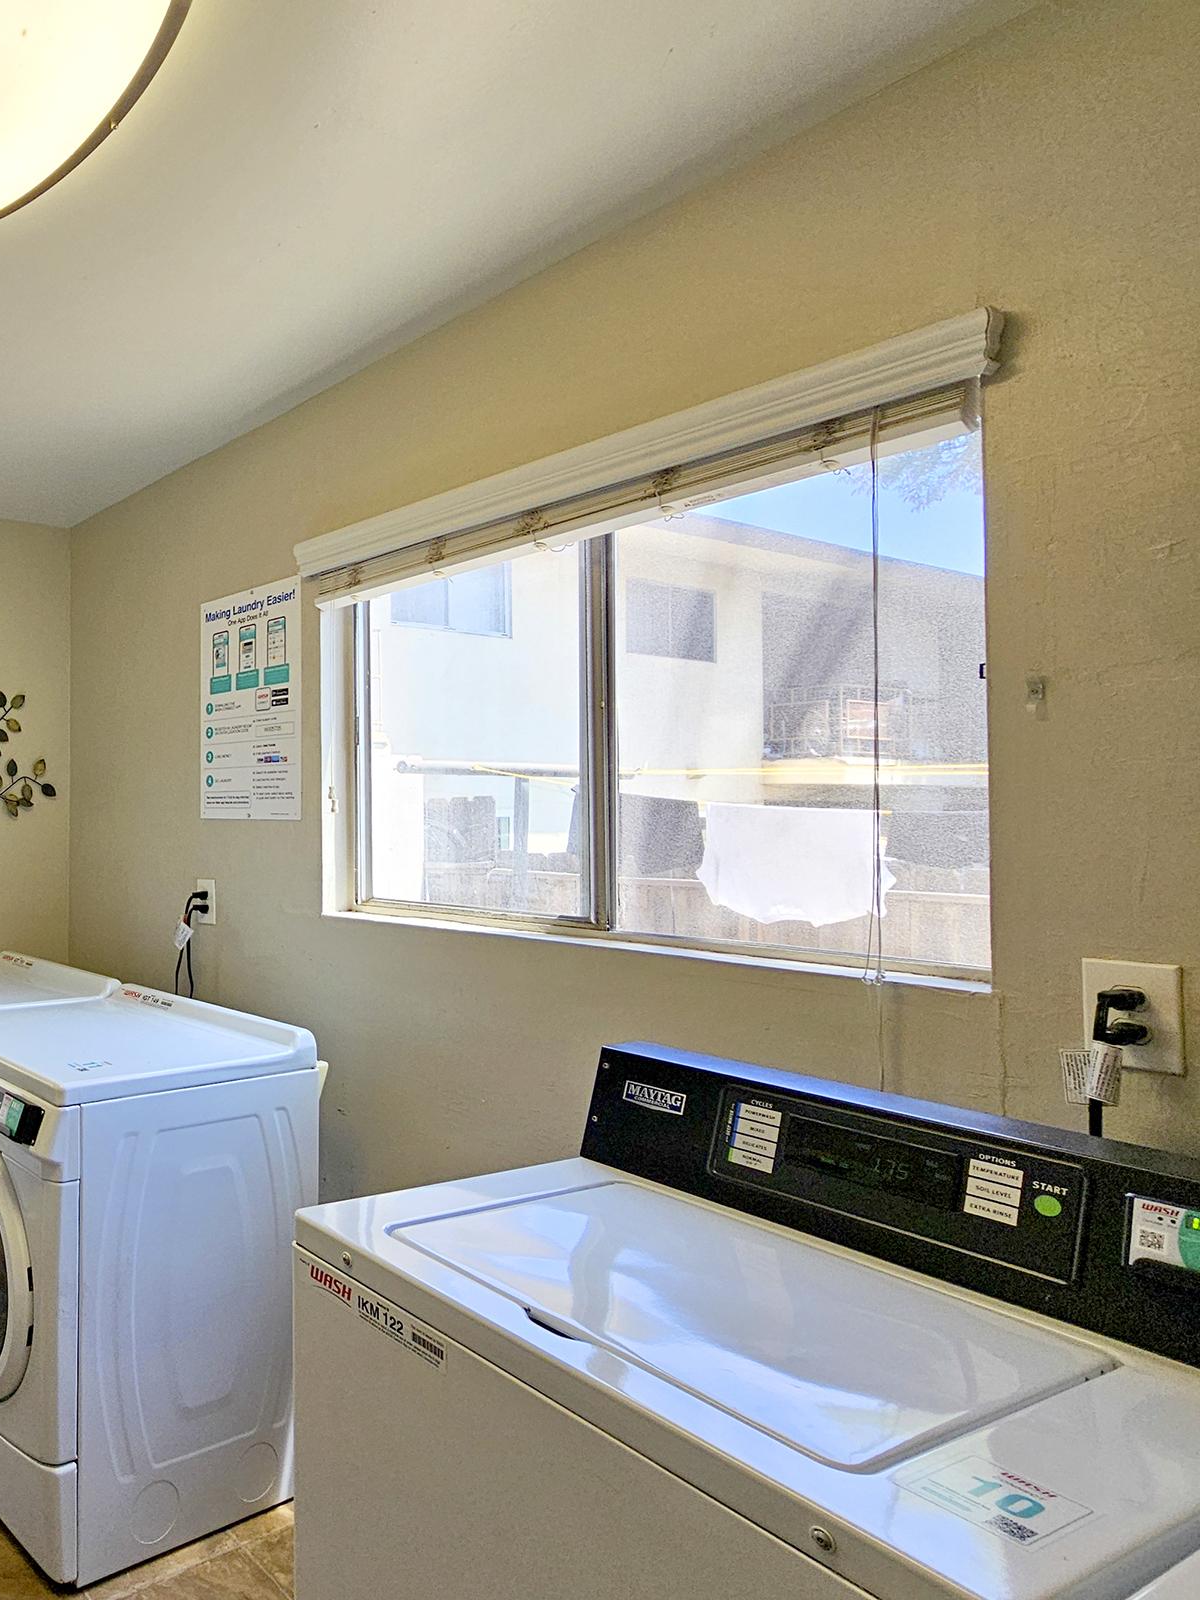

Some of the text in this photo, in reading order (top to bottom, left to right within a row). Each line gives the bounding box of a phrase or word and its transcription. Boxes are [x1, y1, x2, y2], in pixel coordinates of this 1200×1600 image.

[205, 589, 296, 623] Making Laundry Easier!
[238, 616, 246, 624] App
[247, 613, 258, 621] Does
[628, 1084, 681, 1106] MAYTAG
[751, 1099, 773, 1108] CYCLES
[979, 1153, 1017, 1167] OPTIONS
[972, 1165, 1019, 1181] TEMPERATURE
[976, 1185, 1011, 1199] SOIL LEVEL
[1032, 1180, 1069, 1196] START
[970, 1203, 1012, 1219] EXTRA RINSE
[1142, 1203, 1180, 1216] WASH
[309, 1264, 352, 1301] WASH
[357, 1295, 380, 1320] IKM
[383, 1312, 404, 1336] 122
